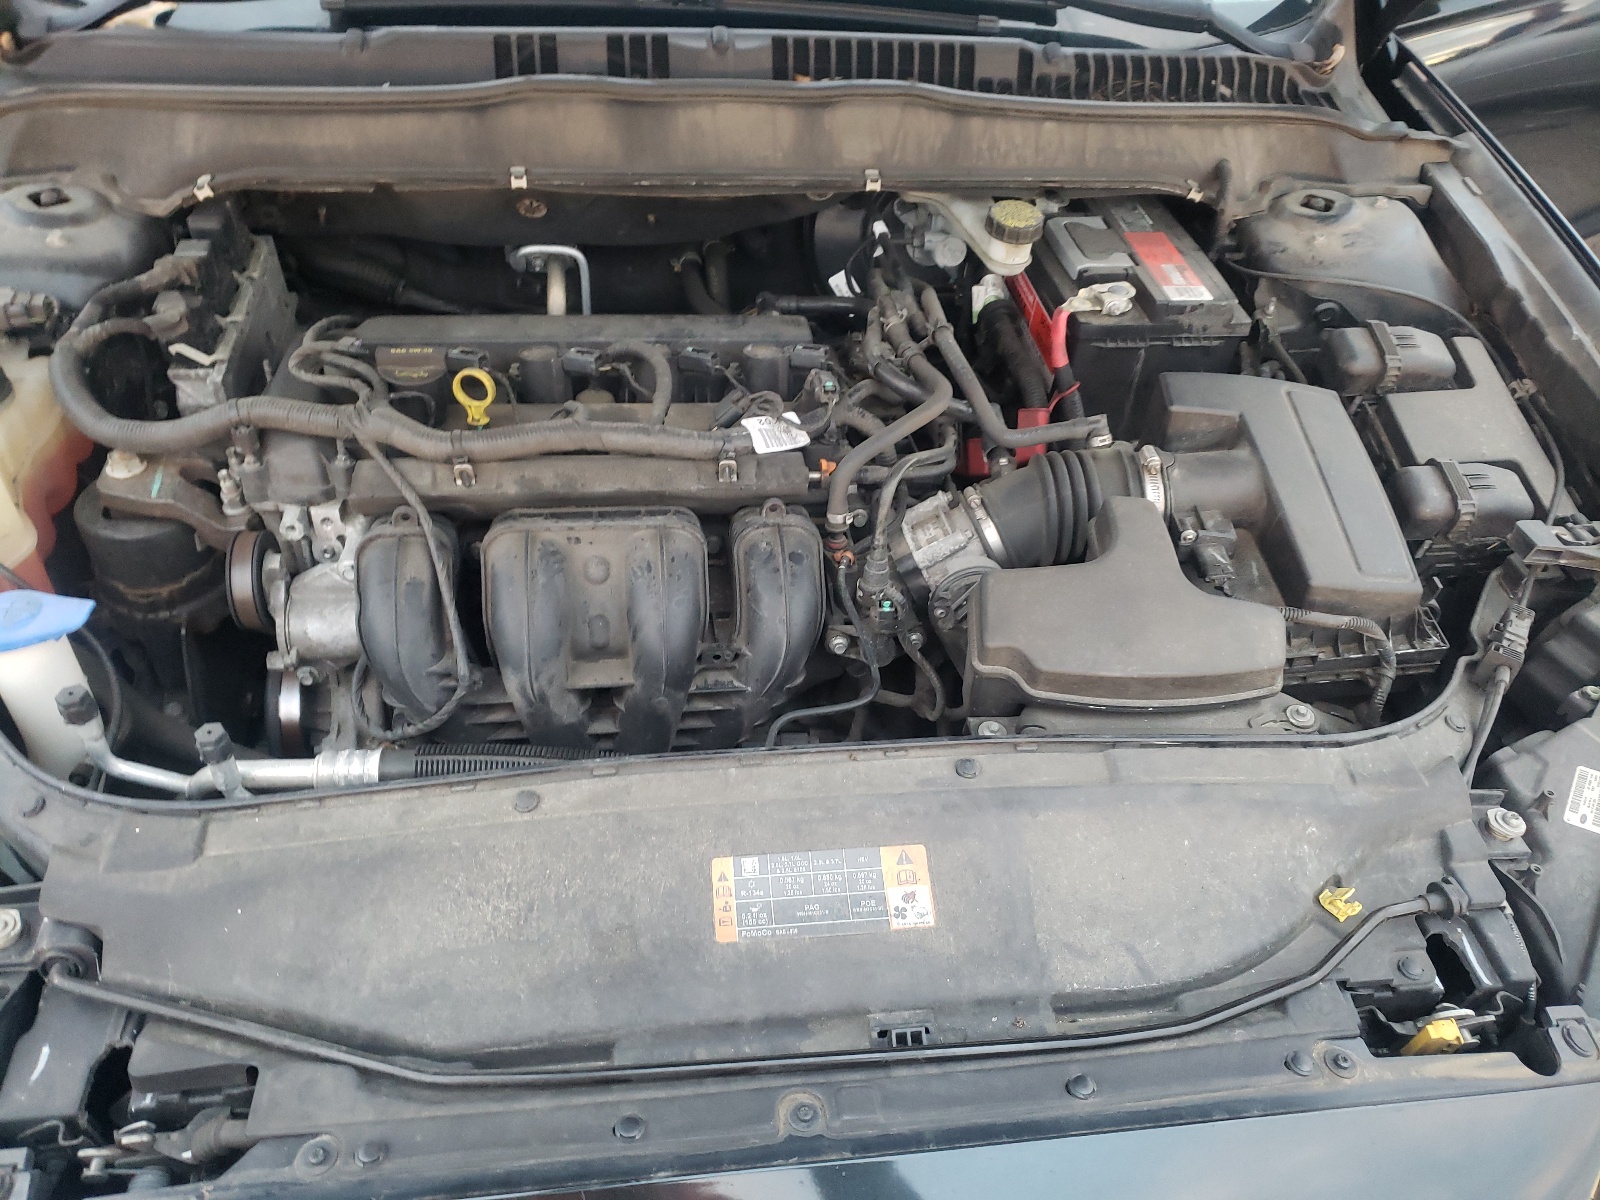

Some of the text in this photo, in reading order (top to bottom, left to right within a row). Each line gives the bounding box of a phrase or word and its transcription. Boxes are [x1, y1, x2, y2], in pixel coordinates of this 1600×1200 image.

[740, 889, 764, 898] R-134a
[804, 903, 820, 912] PAG
[860, 899, 876, 907] POE
